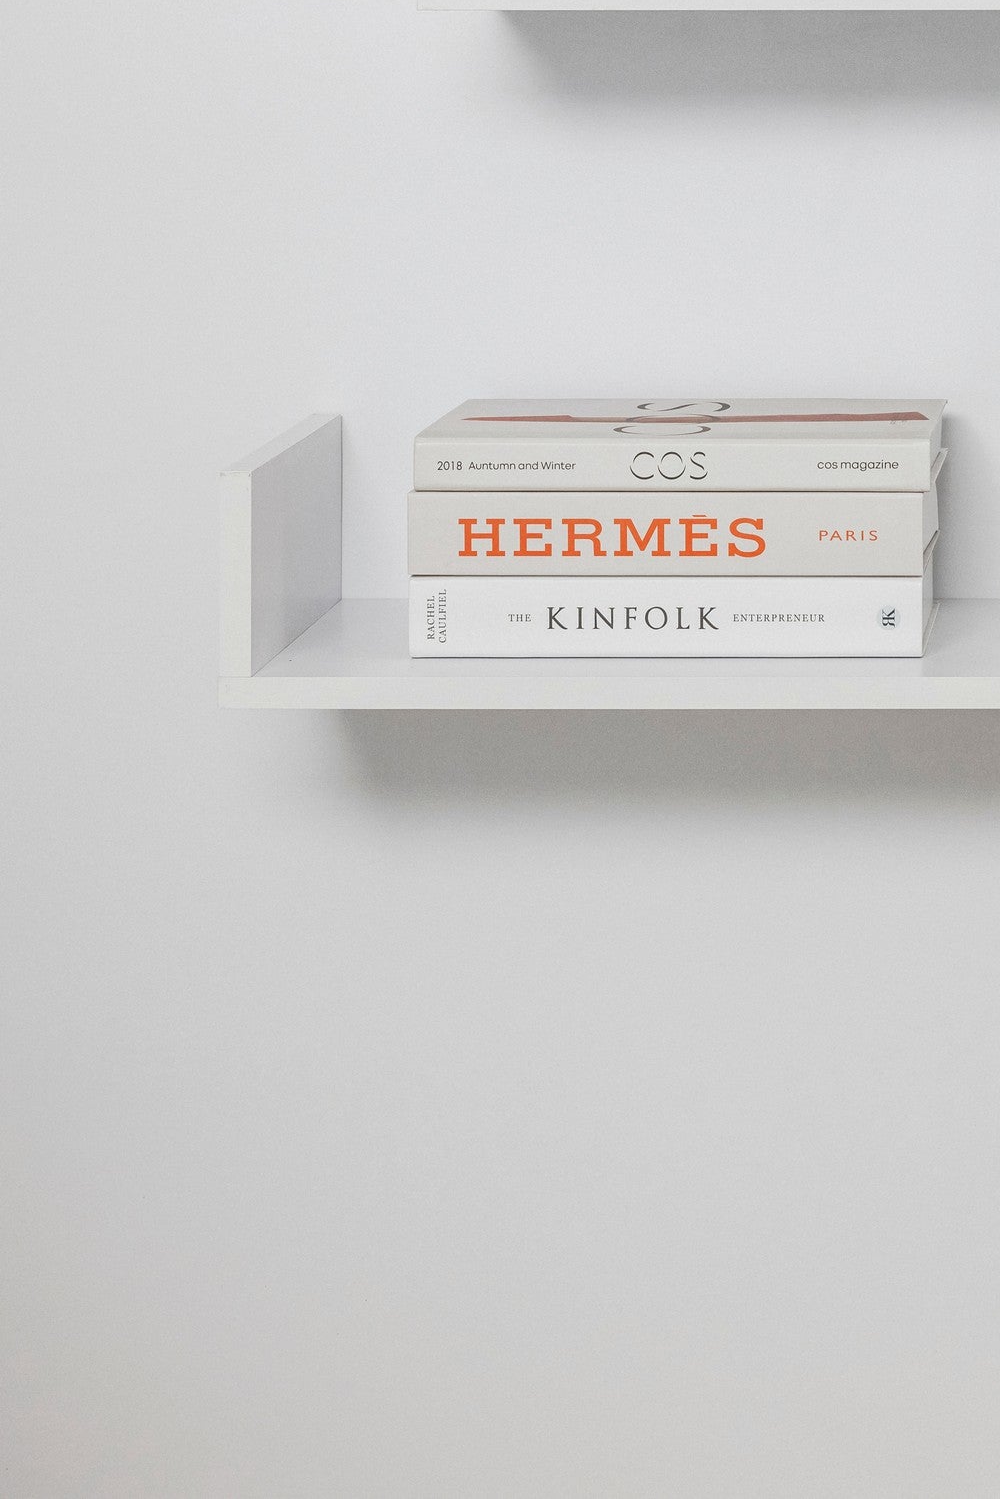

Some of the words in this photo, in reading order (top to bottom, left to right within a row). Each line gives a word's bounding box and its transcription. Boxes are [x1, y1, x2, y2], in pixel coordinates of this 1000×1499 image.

[437, 460, 463, 471] 2018
[468, 461, 516, 471] Auntumn
[518, 461, 539, 471] and
[540, 461, 577, 471] Winter
[629, 451, 708, 481] COS
[817, 461, 838, 470] cos
[840, 459, 899, 472] magazine
[458, 514, 766, 558] HERMÈS
[819, 529, 878, 542] PARIS
[427, 595, 435, 640] RACHEL
[438, 589, 447, 643] CAULFIEL
[508, 613, 532, 622] THE
[546, 606, 720, 631] KINFOLK
[733, 613, 825, 623] ENTERPRENEUR
